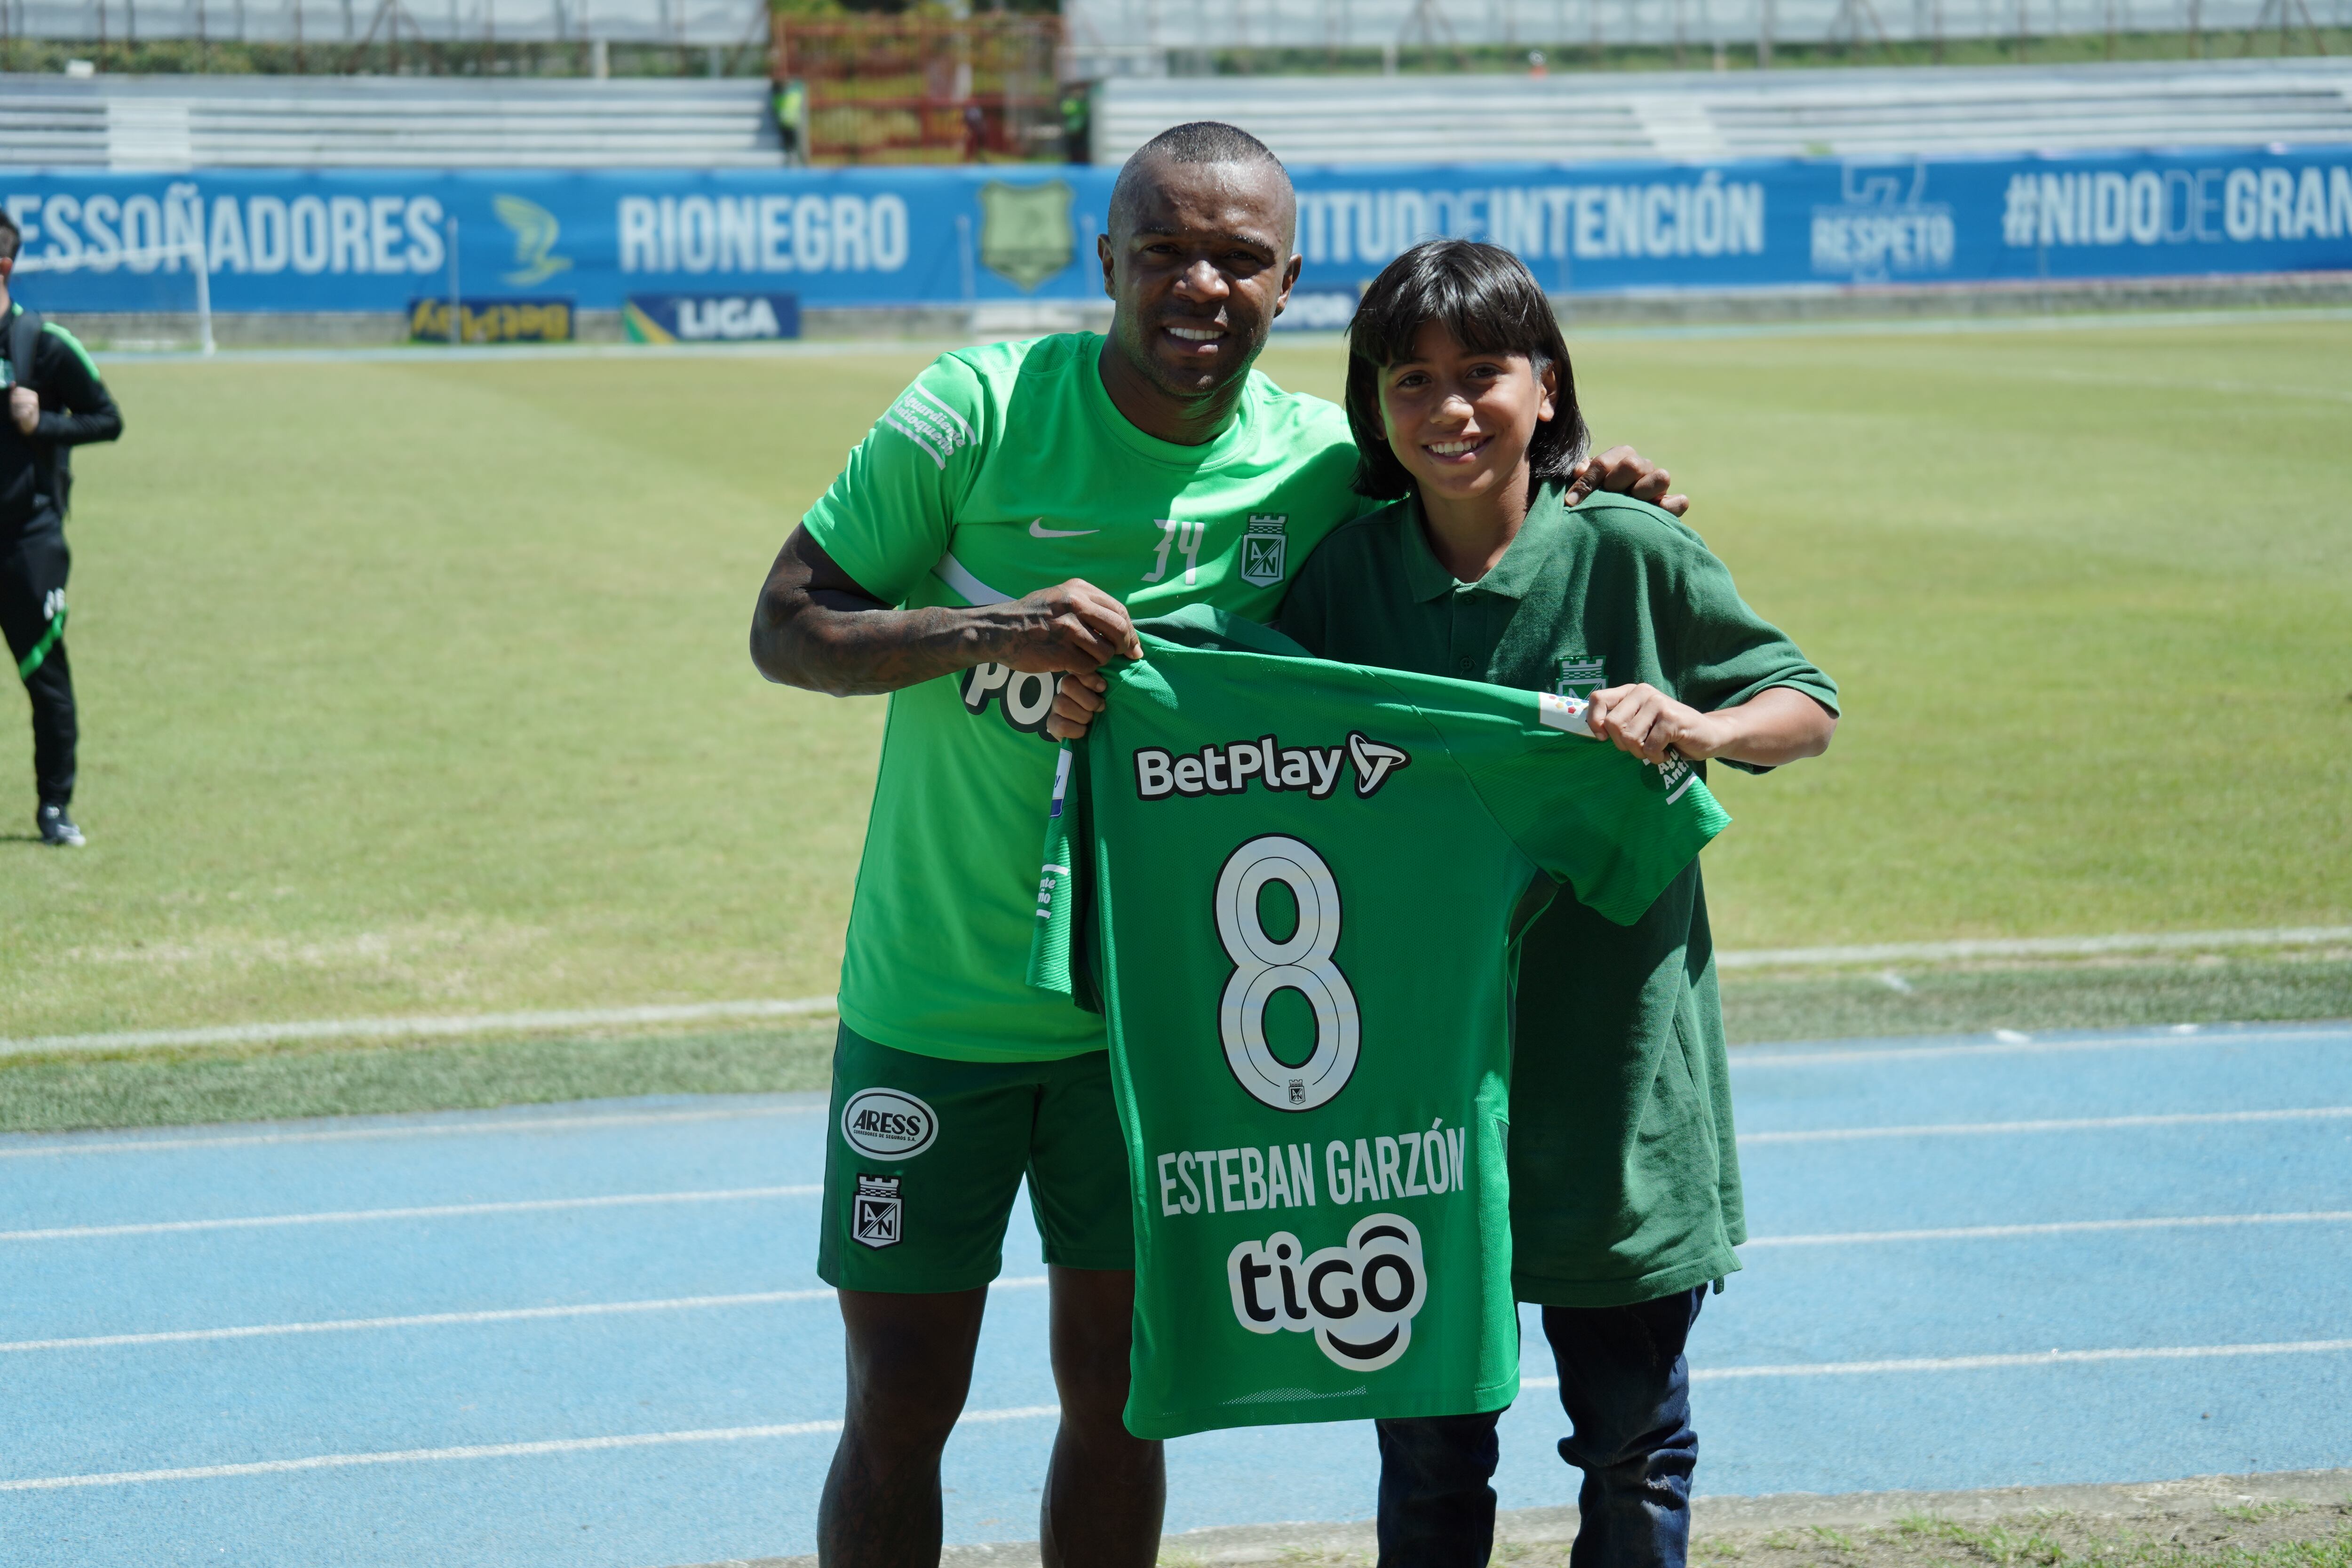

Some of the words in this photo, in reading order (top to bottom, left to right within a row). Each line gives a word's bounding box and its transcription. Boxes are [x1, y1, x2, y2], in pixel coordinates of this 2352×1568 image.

[618, 194, 909, 273] RIONEGRO
[677, 296, 780, 338] LIGA
[893, 401, 954, 456] Antioqueño
[903, 391, 966, 447] Aguardiente
[1141, 519, 1204, 585] 34
[965, 662, 1067, 725] PO
[1137, 738, 1342, 795] BetPlay
[1212, 832, 1362, 1113] 8
[853, 1109, 921, 1136] ARESS
[1157, 1143, 1316, 1217] ESTEBAN
[1326, 1117, 1465, 1205] GARZÓN
